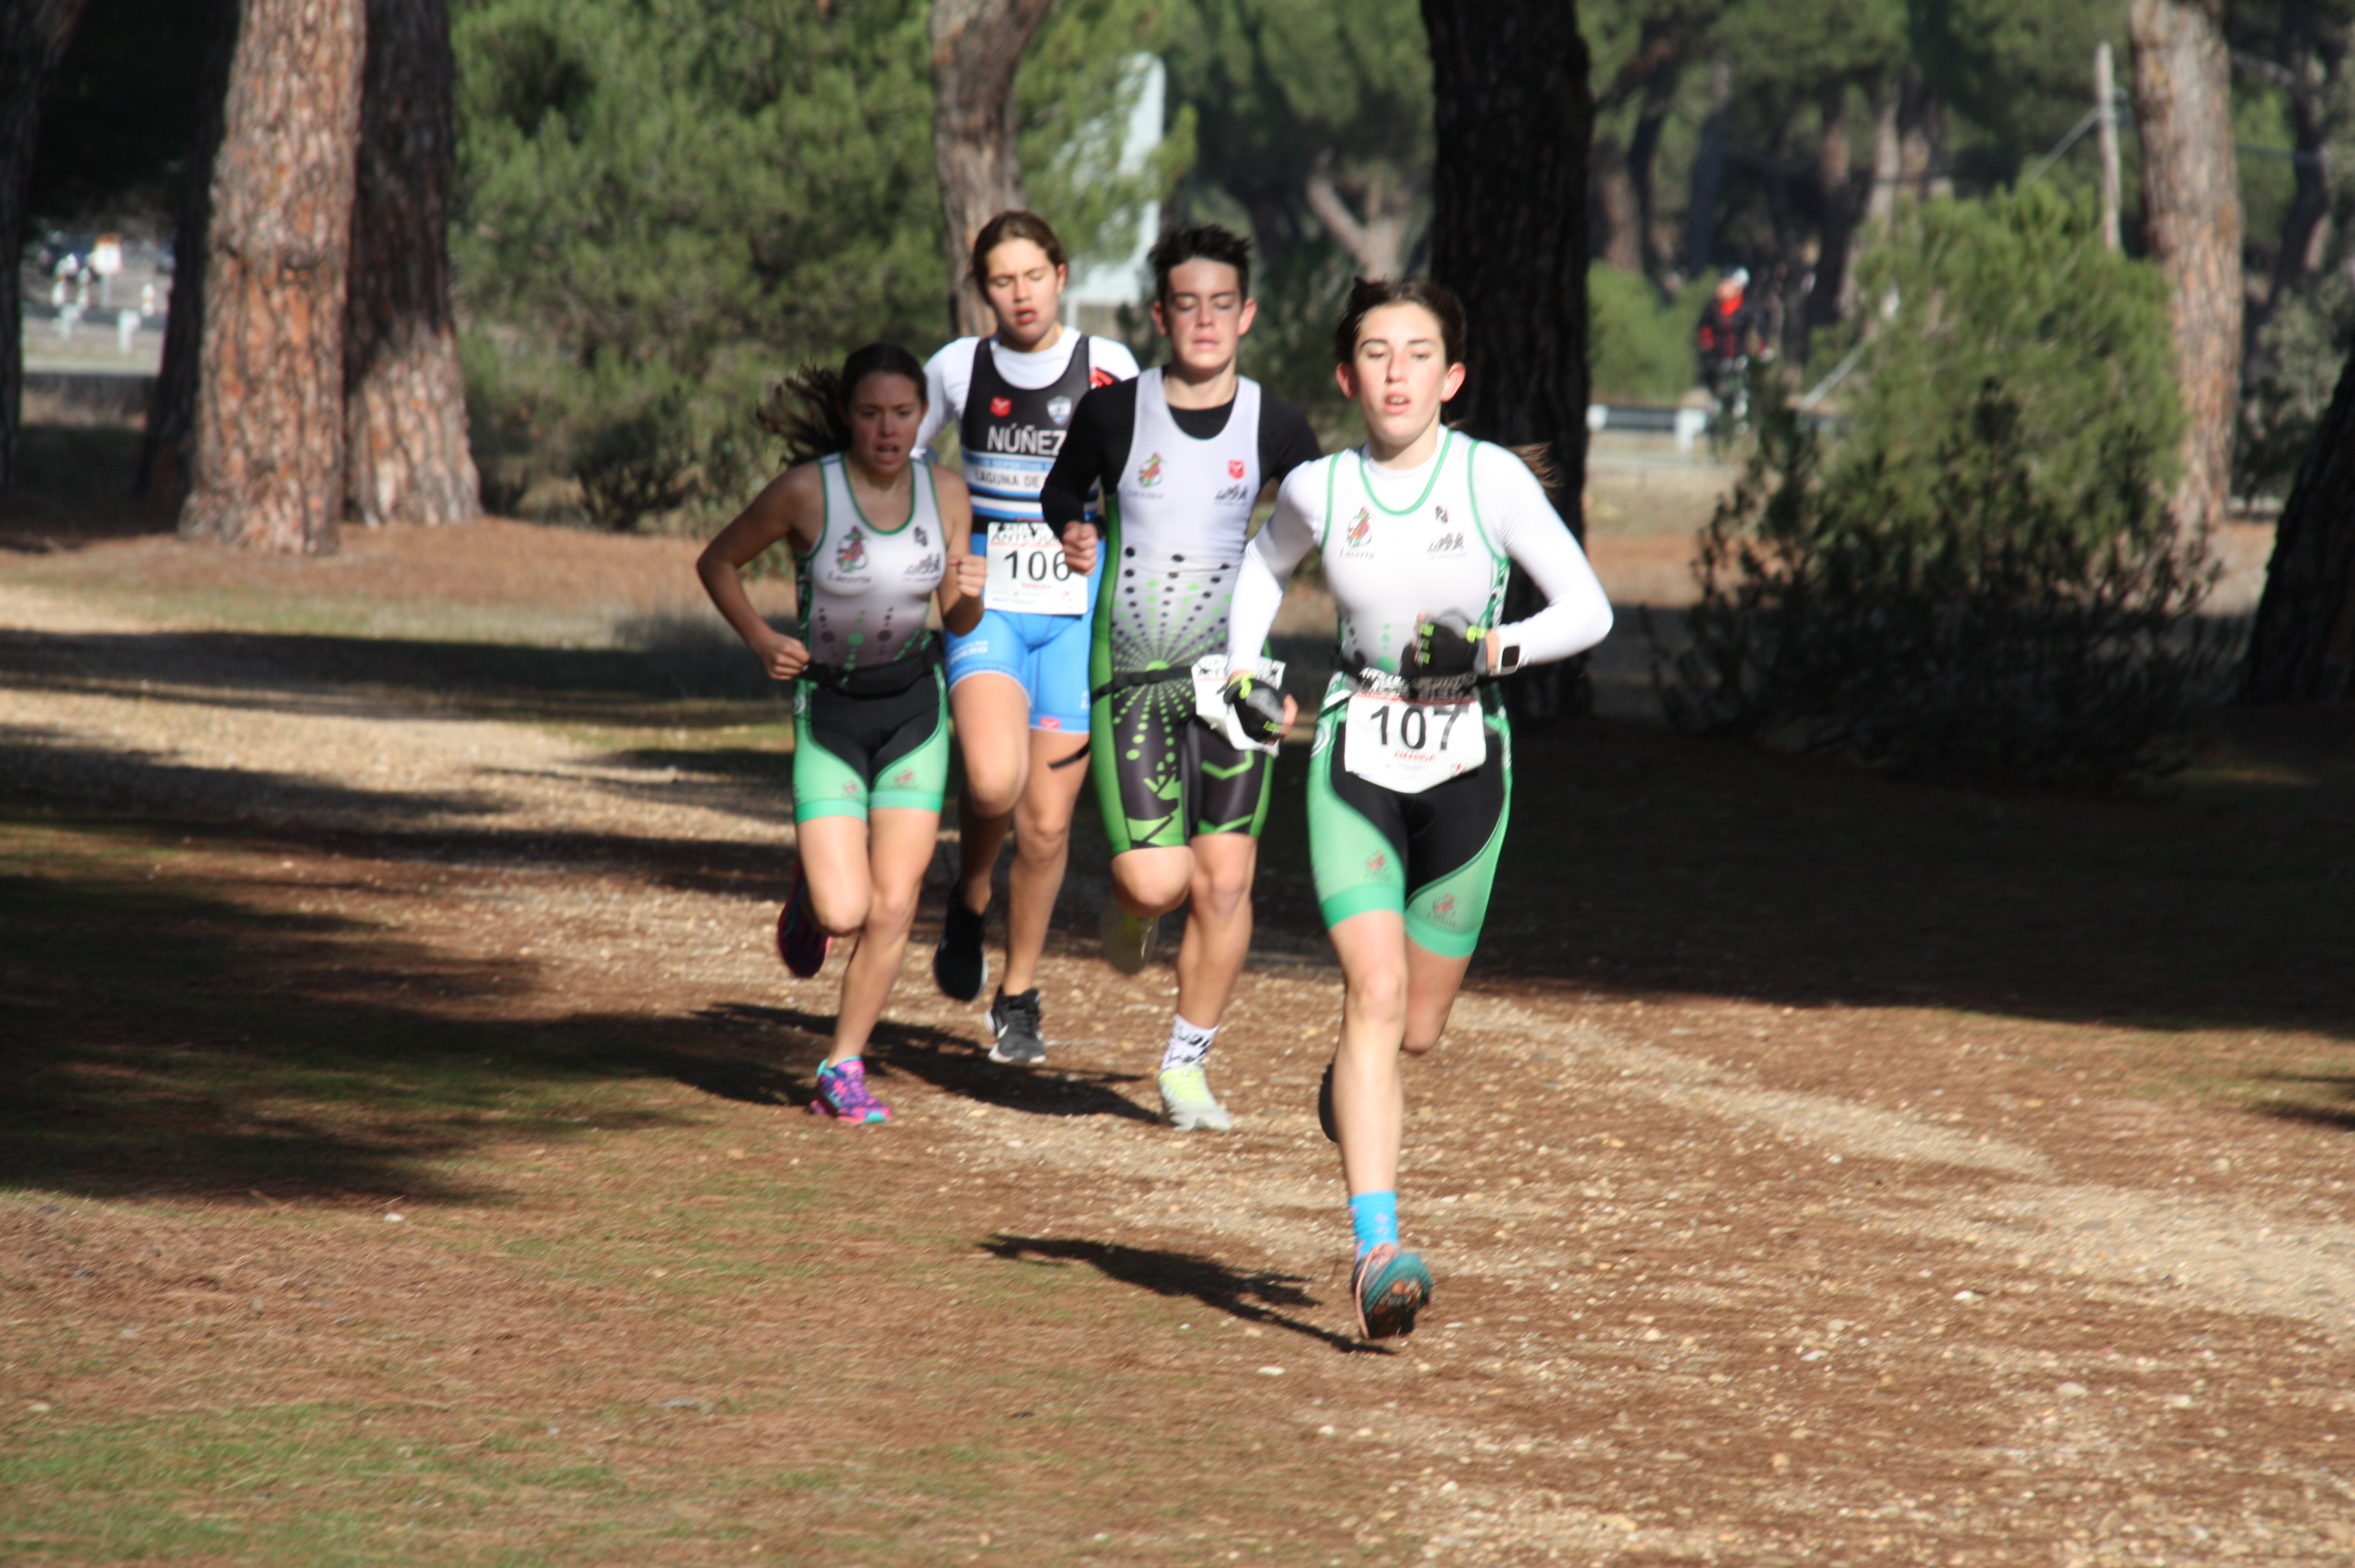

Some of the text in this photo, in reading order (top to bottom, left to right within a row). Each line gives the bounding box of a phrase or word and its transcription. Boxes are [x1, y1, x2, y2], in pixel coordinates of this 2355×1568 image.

[987, 423, 1068, 456] NÚÑEZ
[974, 470, 1018, 486] LAGUNA
[1004, 550, 1070, 582] 106
[1370, 702, 1469, 750] 107
